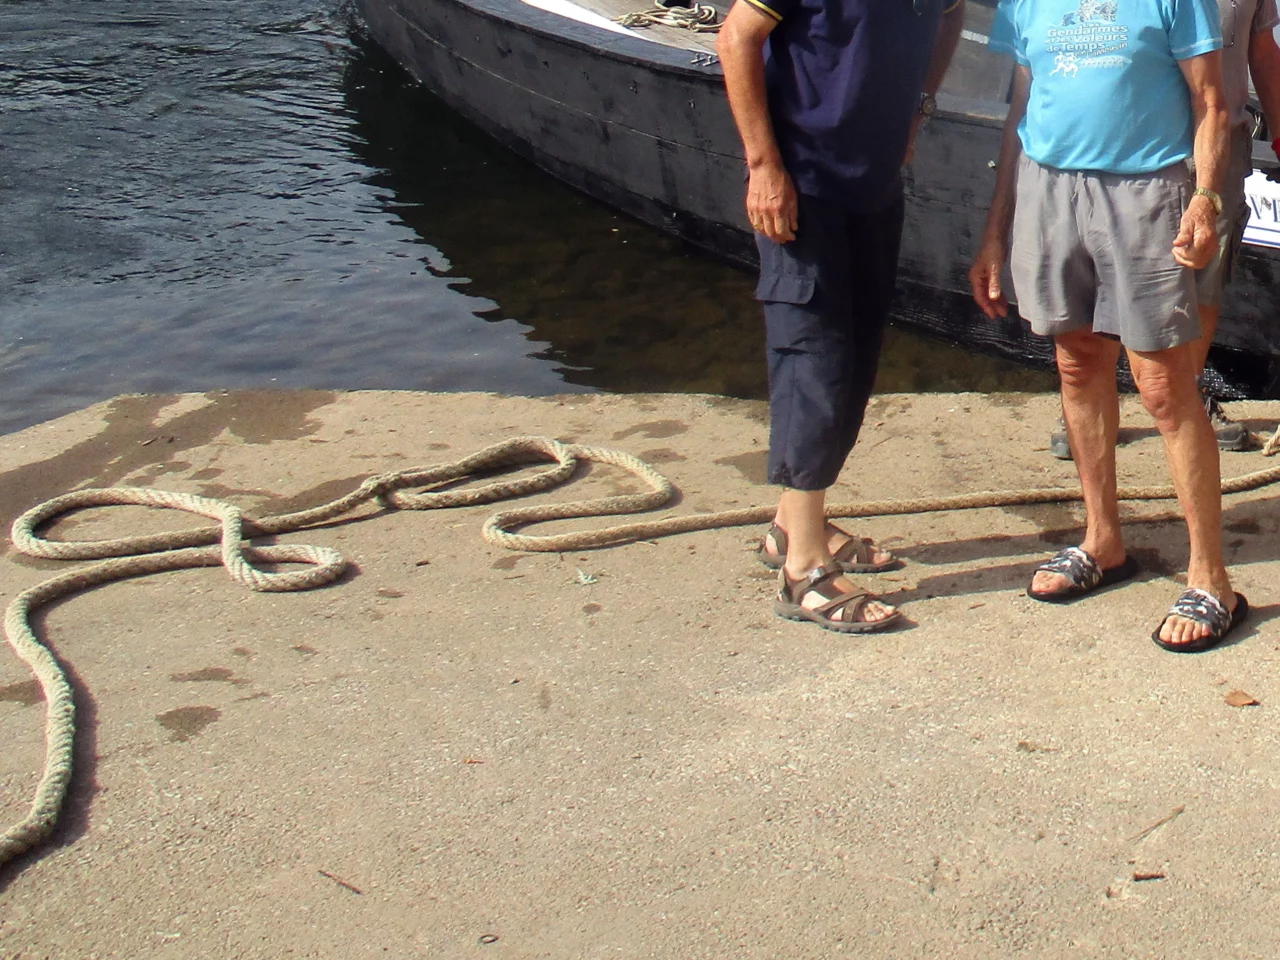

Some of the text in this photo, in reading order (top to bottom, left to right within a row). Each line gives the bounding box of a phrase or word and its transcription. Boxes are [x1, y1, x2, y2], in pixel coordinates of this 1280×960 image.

[1047, 25, 1129, 37] Gendarmes
[1046, 42, 1106, 52] de Temps
